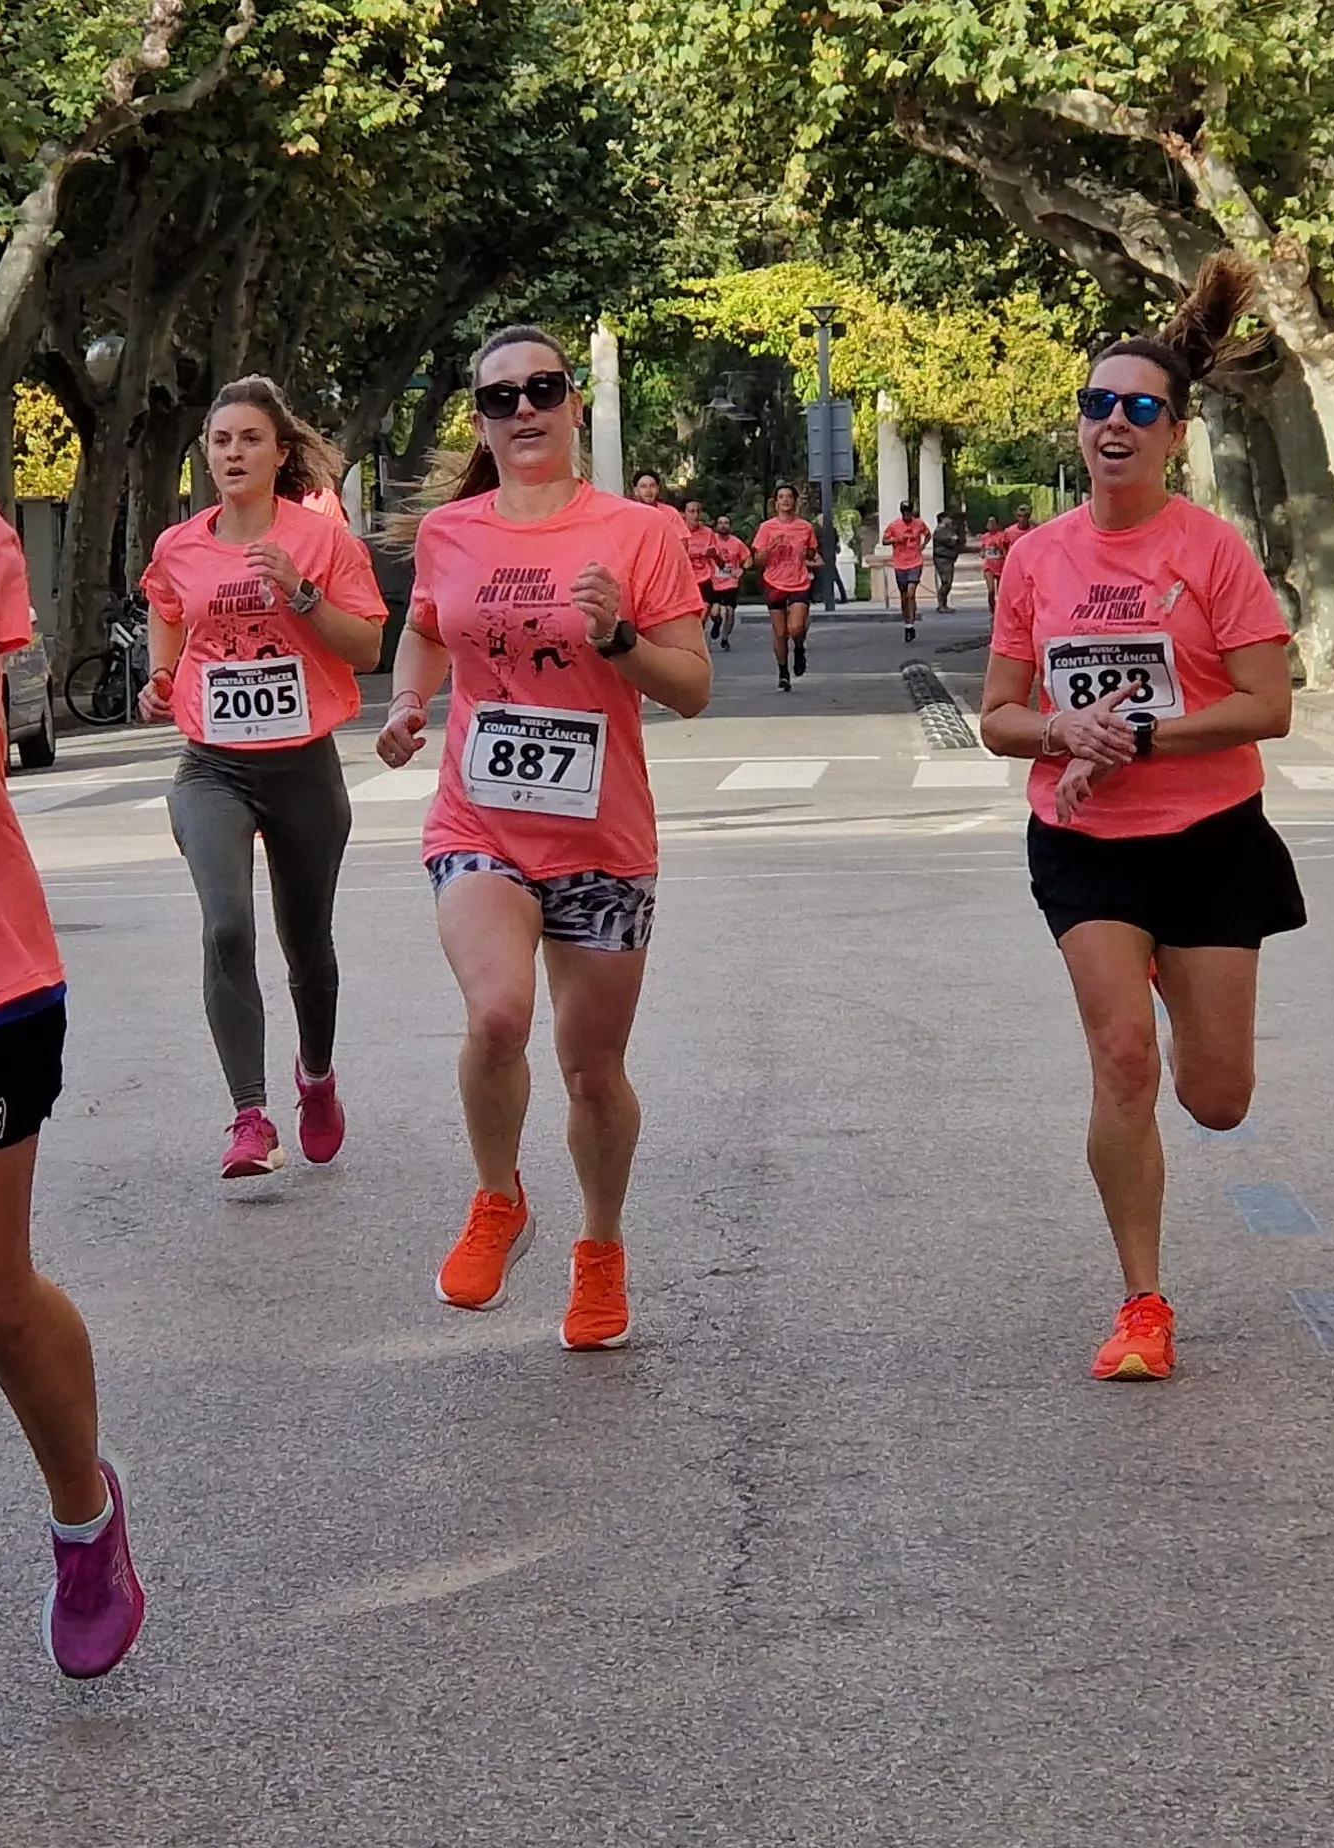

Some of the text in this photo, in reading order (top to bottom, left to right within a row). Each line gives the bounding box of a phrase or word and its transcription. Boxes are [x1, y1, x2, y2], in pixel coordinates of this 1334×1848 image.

[491, 568, 551, 584] CORRAMOS
[475, 583, 557, 604] POR LA CIENCIA
[1088, 584, 1143, 604] CORRAMOS
[208, 599, 223, 616] POR
[224, 598, 234, 614] LA
[1070, 600, 1147, 620] POR LA CIENCIA
[1054, 652, 1160, 668] CONTRA EL CÁNCER
[213, 677, 245, 686] CONTRA
[245, 676, 256, 685] EL
[213, 685, 297, 719] 2005
[483, 722, 591, 743] CONTRA EL CÁNCER
[519, 717, 553, 728] HUESCA
[488, 740, 576, 783] 887
